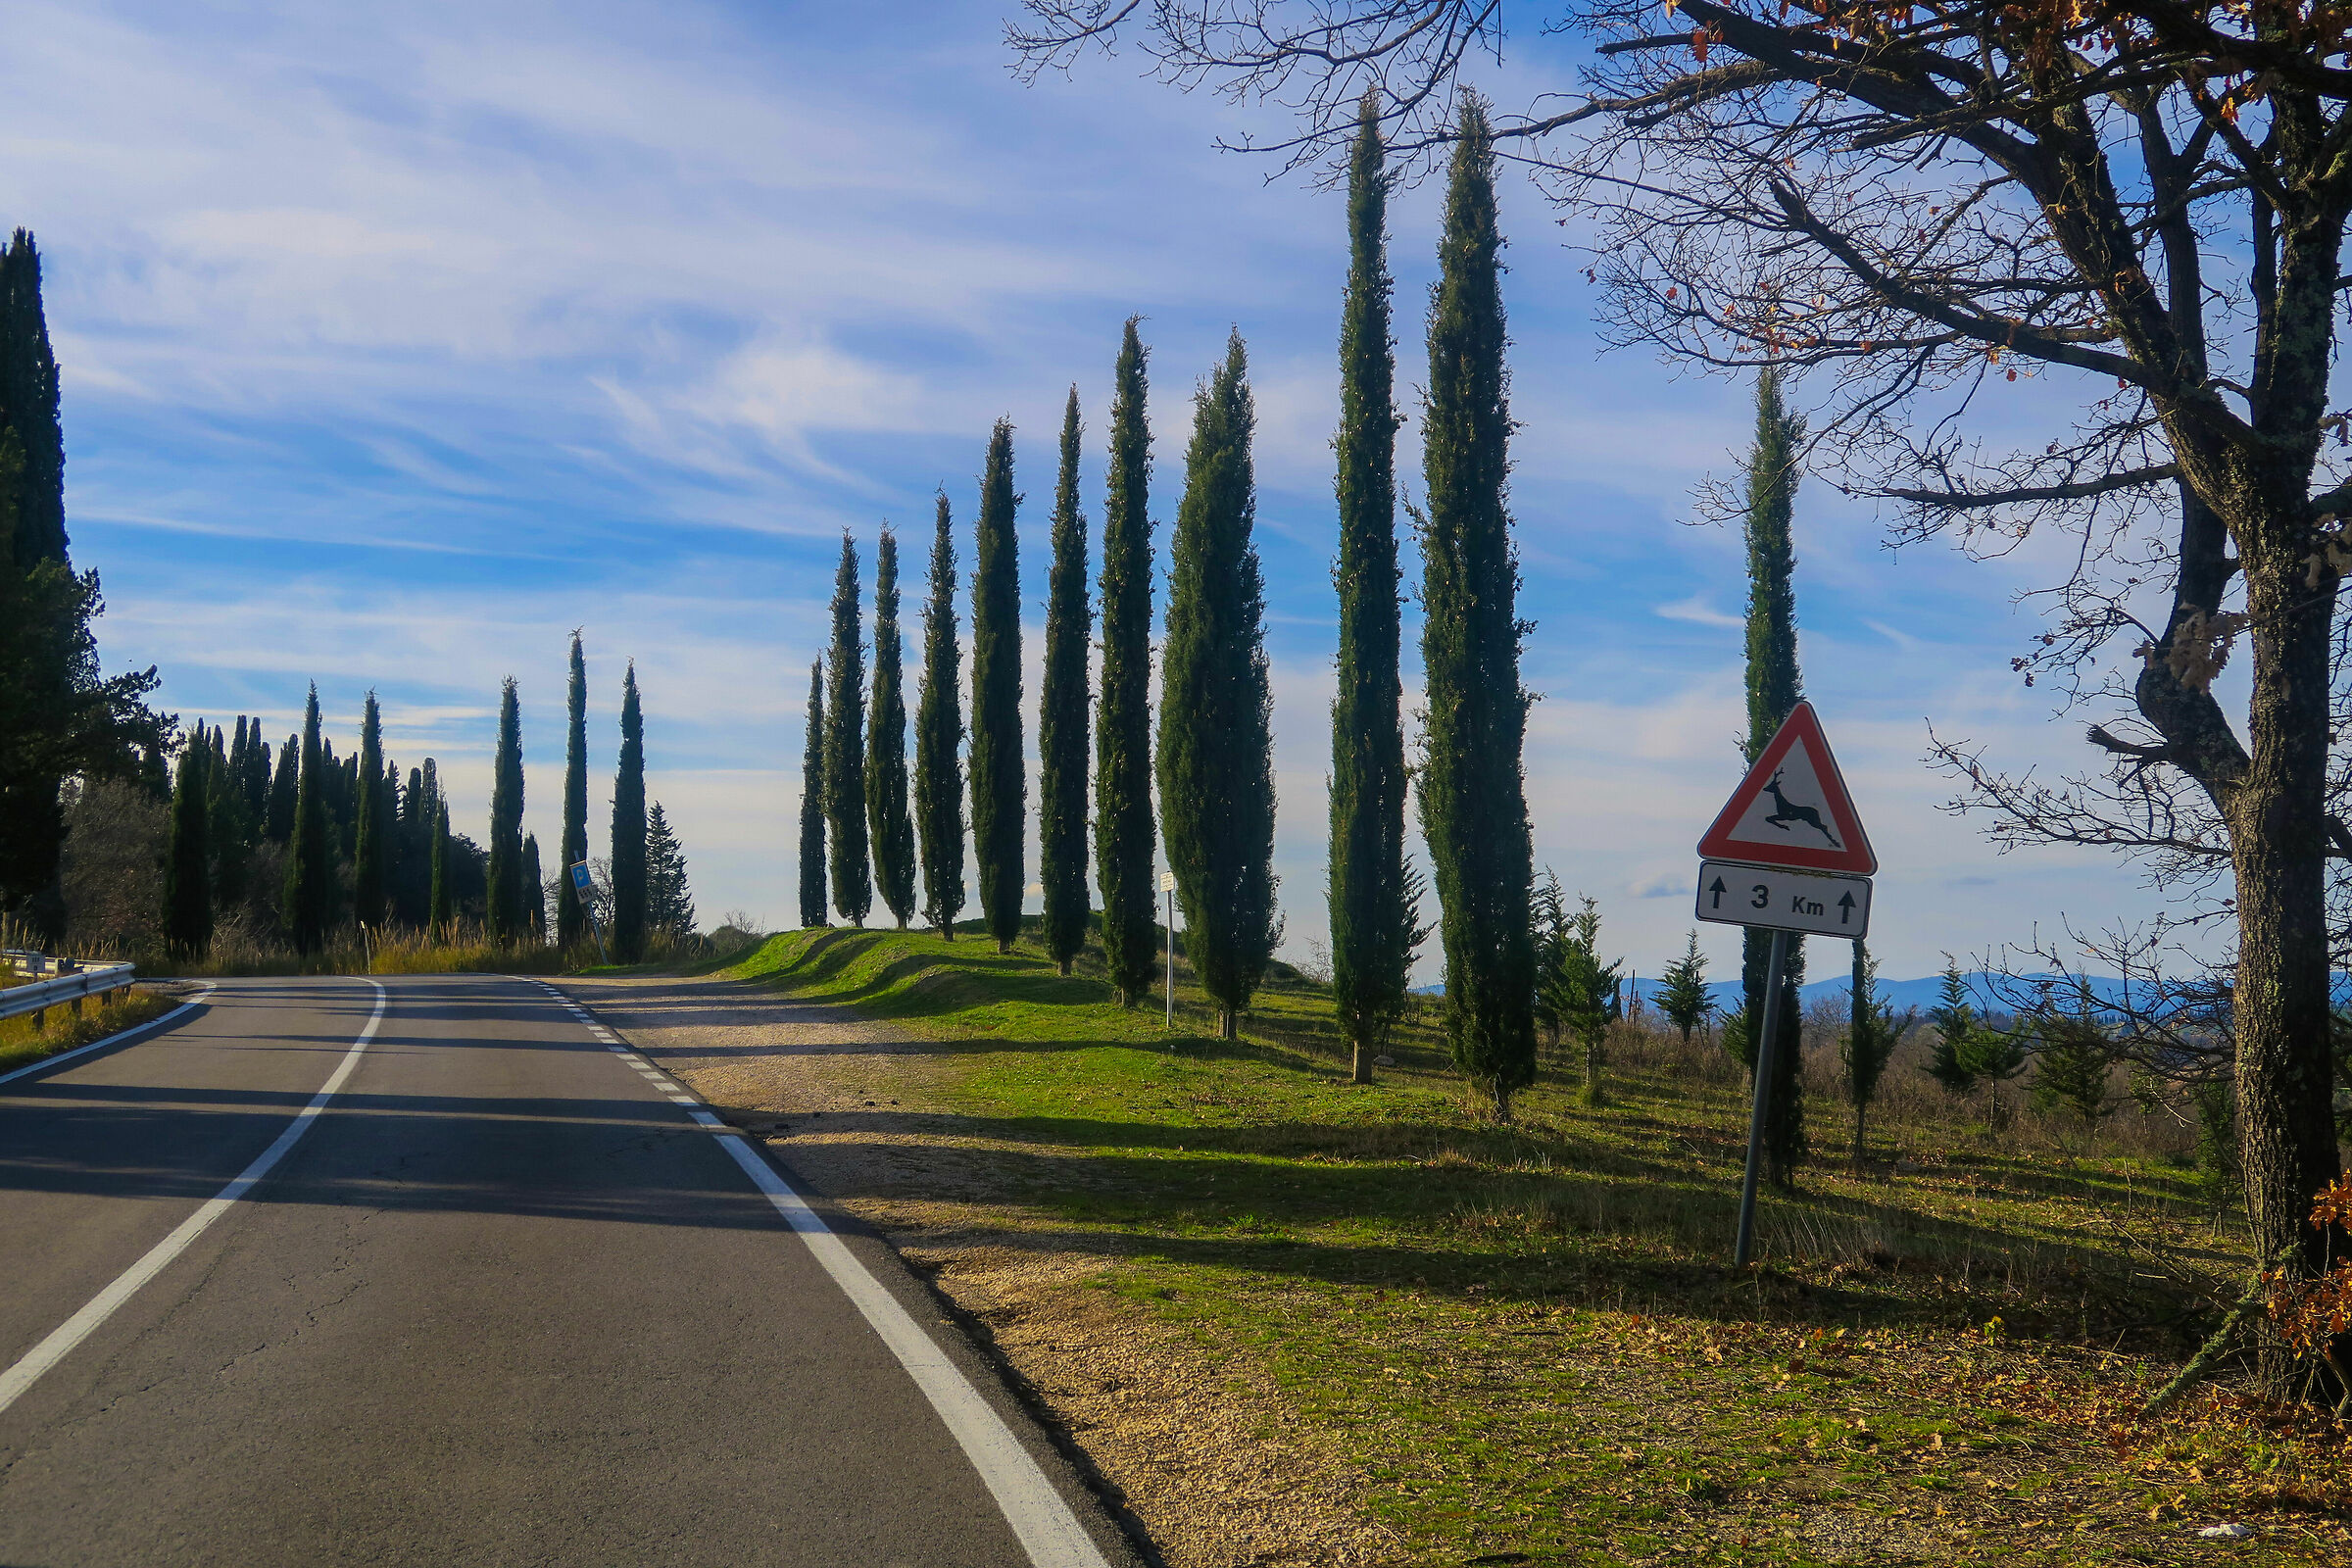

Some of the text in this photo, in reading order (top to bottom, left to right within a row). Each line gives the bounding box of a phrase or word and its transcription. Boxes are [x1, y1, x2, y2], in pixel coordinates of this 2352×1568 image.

[576, 869, 584, 885] P
[1751, 884, 1825, 916] 3 Km
